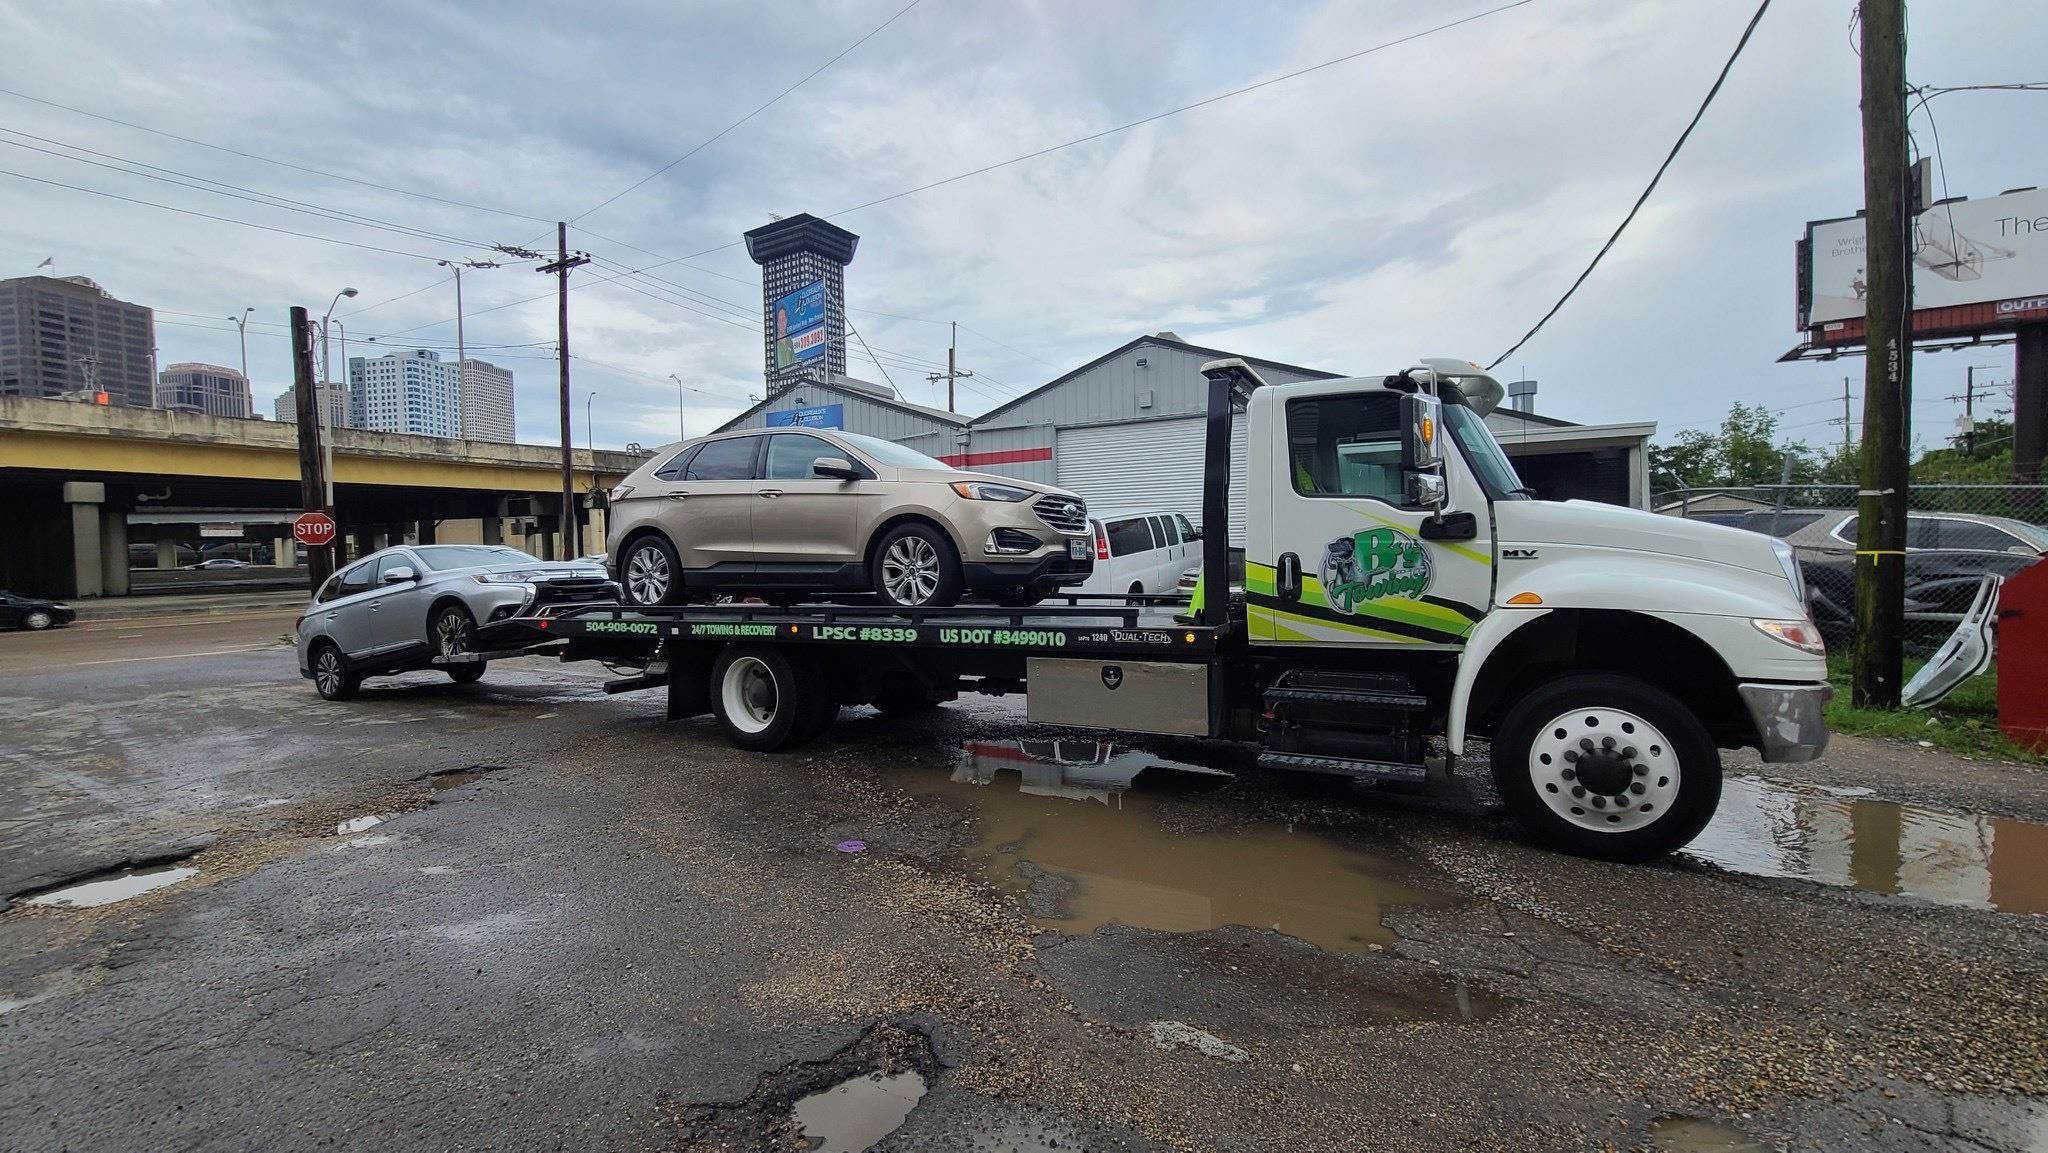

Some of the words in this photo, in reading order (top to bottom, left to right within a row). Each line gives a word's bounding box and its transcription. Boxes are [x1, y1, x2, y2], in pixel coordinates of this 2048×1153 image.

[1993, 216, 2048, 237] The
[1886, 338, 1898, 382] 4534
[296, 523, 333, 535] STOP
[1354, 528, 1422, 572] B's
[1331, 573, 1427, 613] Towing
[585, 621, 658, 635] 504-908-0072
[691, 624, 706, 635] 24/7
[706, 624, 734, 636] TOWING
[734, 625, 741, 636] &
[740, 625, 777, 636] RECOVERY
[812, 626, 857, 640] LPSC
[859, 627, 918, 643] #8339
[940, 629, 959, 644] US
[961, 629, 992, 645] DOT
[992, 629, 1067, 647] #3499010
